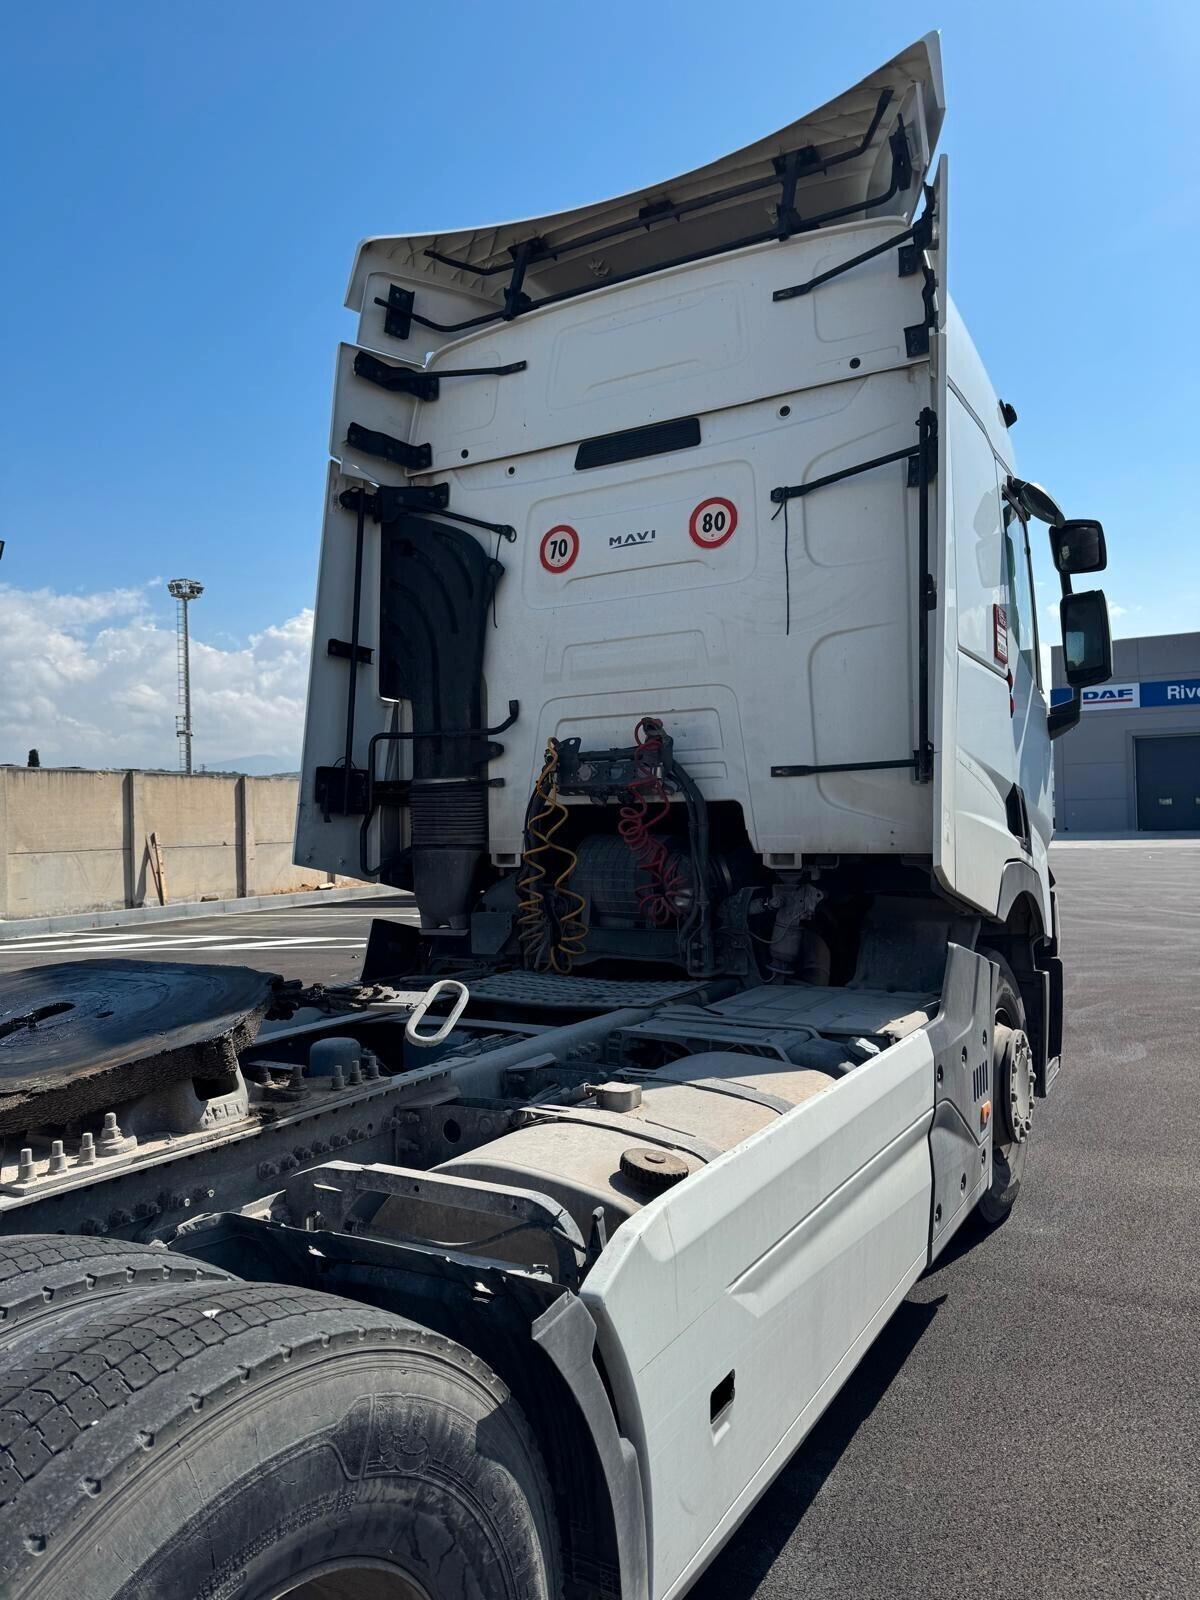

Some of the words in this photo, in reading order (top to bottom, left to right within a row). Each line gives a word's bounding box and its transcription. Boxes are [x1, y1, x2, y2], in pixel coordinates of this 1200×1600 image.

[702, 511, 726, 533] 80
[609, 530, 656, 547] MAVI
[550, 539, 568, 559] 70
[1083, 688, 1133, 700] DAF
